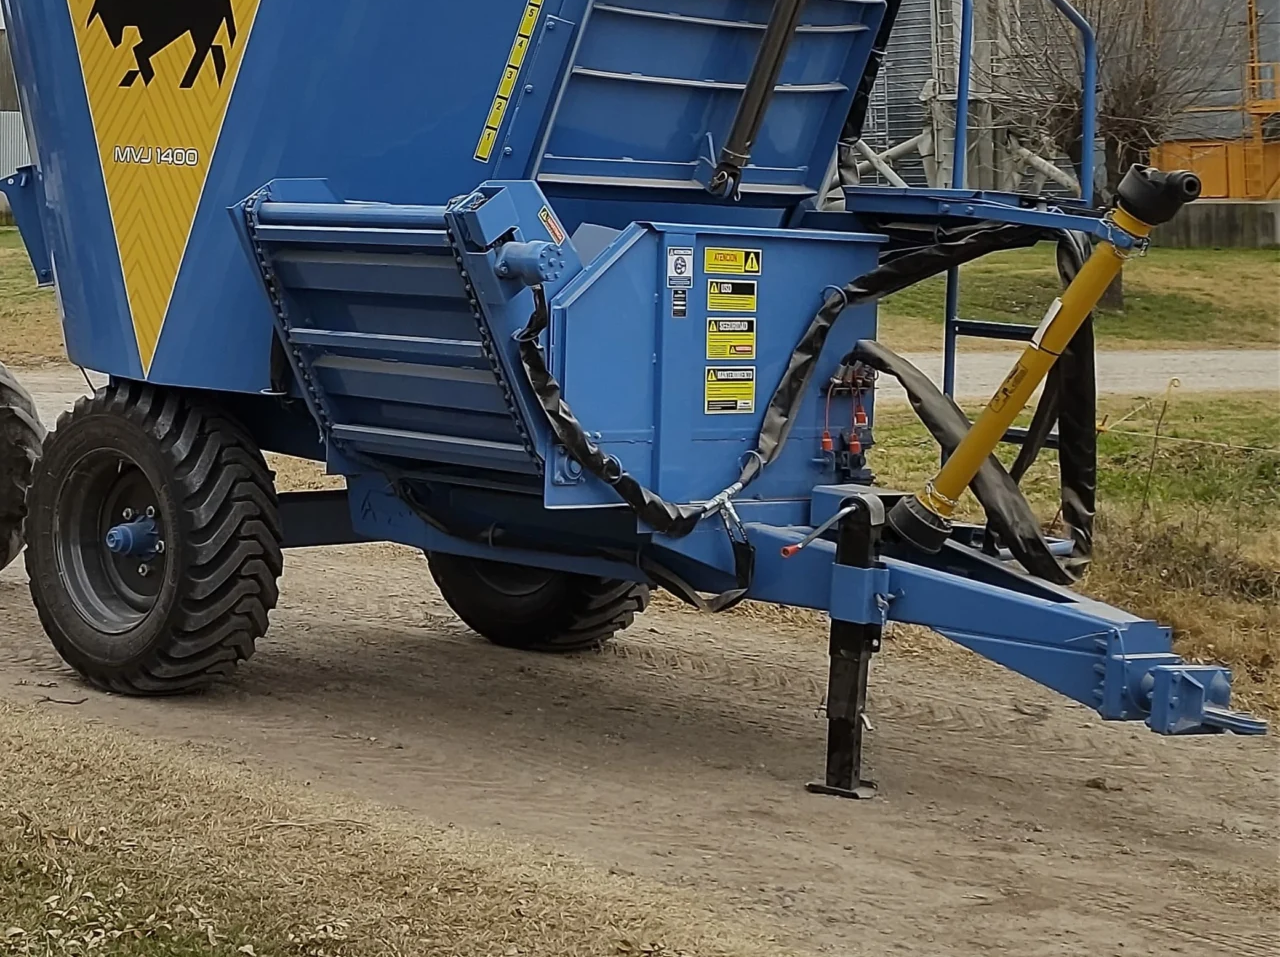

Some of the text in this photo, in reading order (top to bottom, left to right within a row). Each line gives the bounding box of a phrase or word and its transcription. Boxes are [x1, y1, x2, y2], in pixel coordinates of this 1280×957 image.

[528, 8, 535, 17] 5
[517, 40, 524, 49] 4
[506, 70, 513, 79] 3
[496, 102, 503, 111] 2
[114, 145, 199, 166] MVJ 1400
